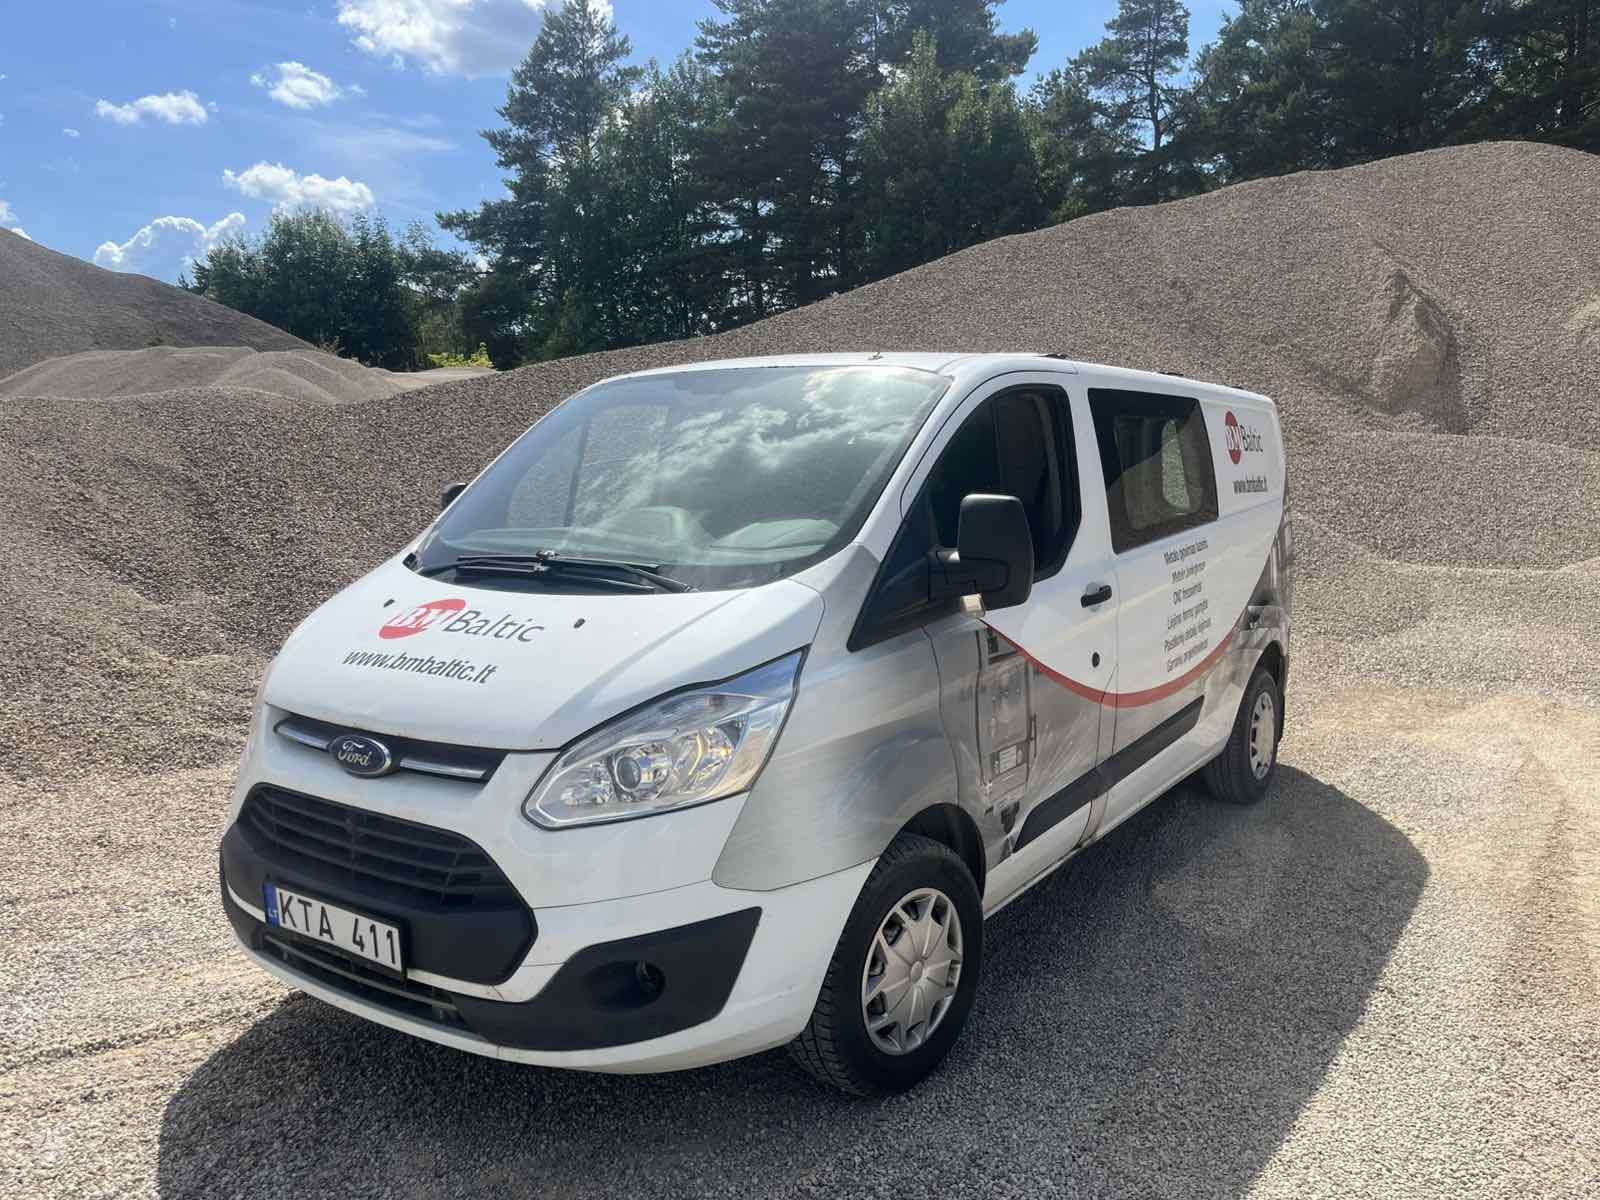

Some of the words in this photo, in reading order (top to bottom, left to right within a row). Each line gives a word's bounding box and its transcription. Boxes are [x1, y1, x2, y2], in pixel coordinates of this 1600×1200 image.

[443, 610, 545, 642] Baltic
[342, 651, 499, 684] www.bmbaltic.lt
[337, 740, 372, 767] Ford
[279, 891, 335, 941] KTA
[352, 918, 396, 965] 411
